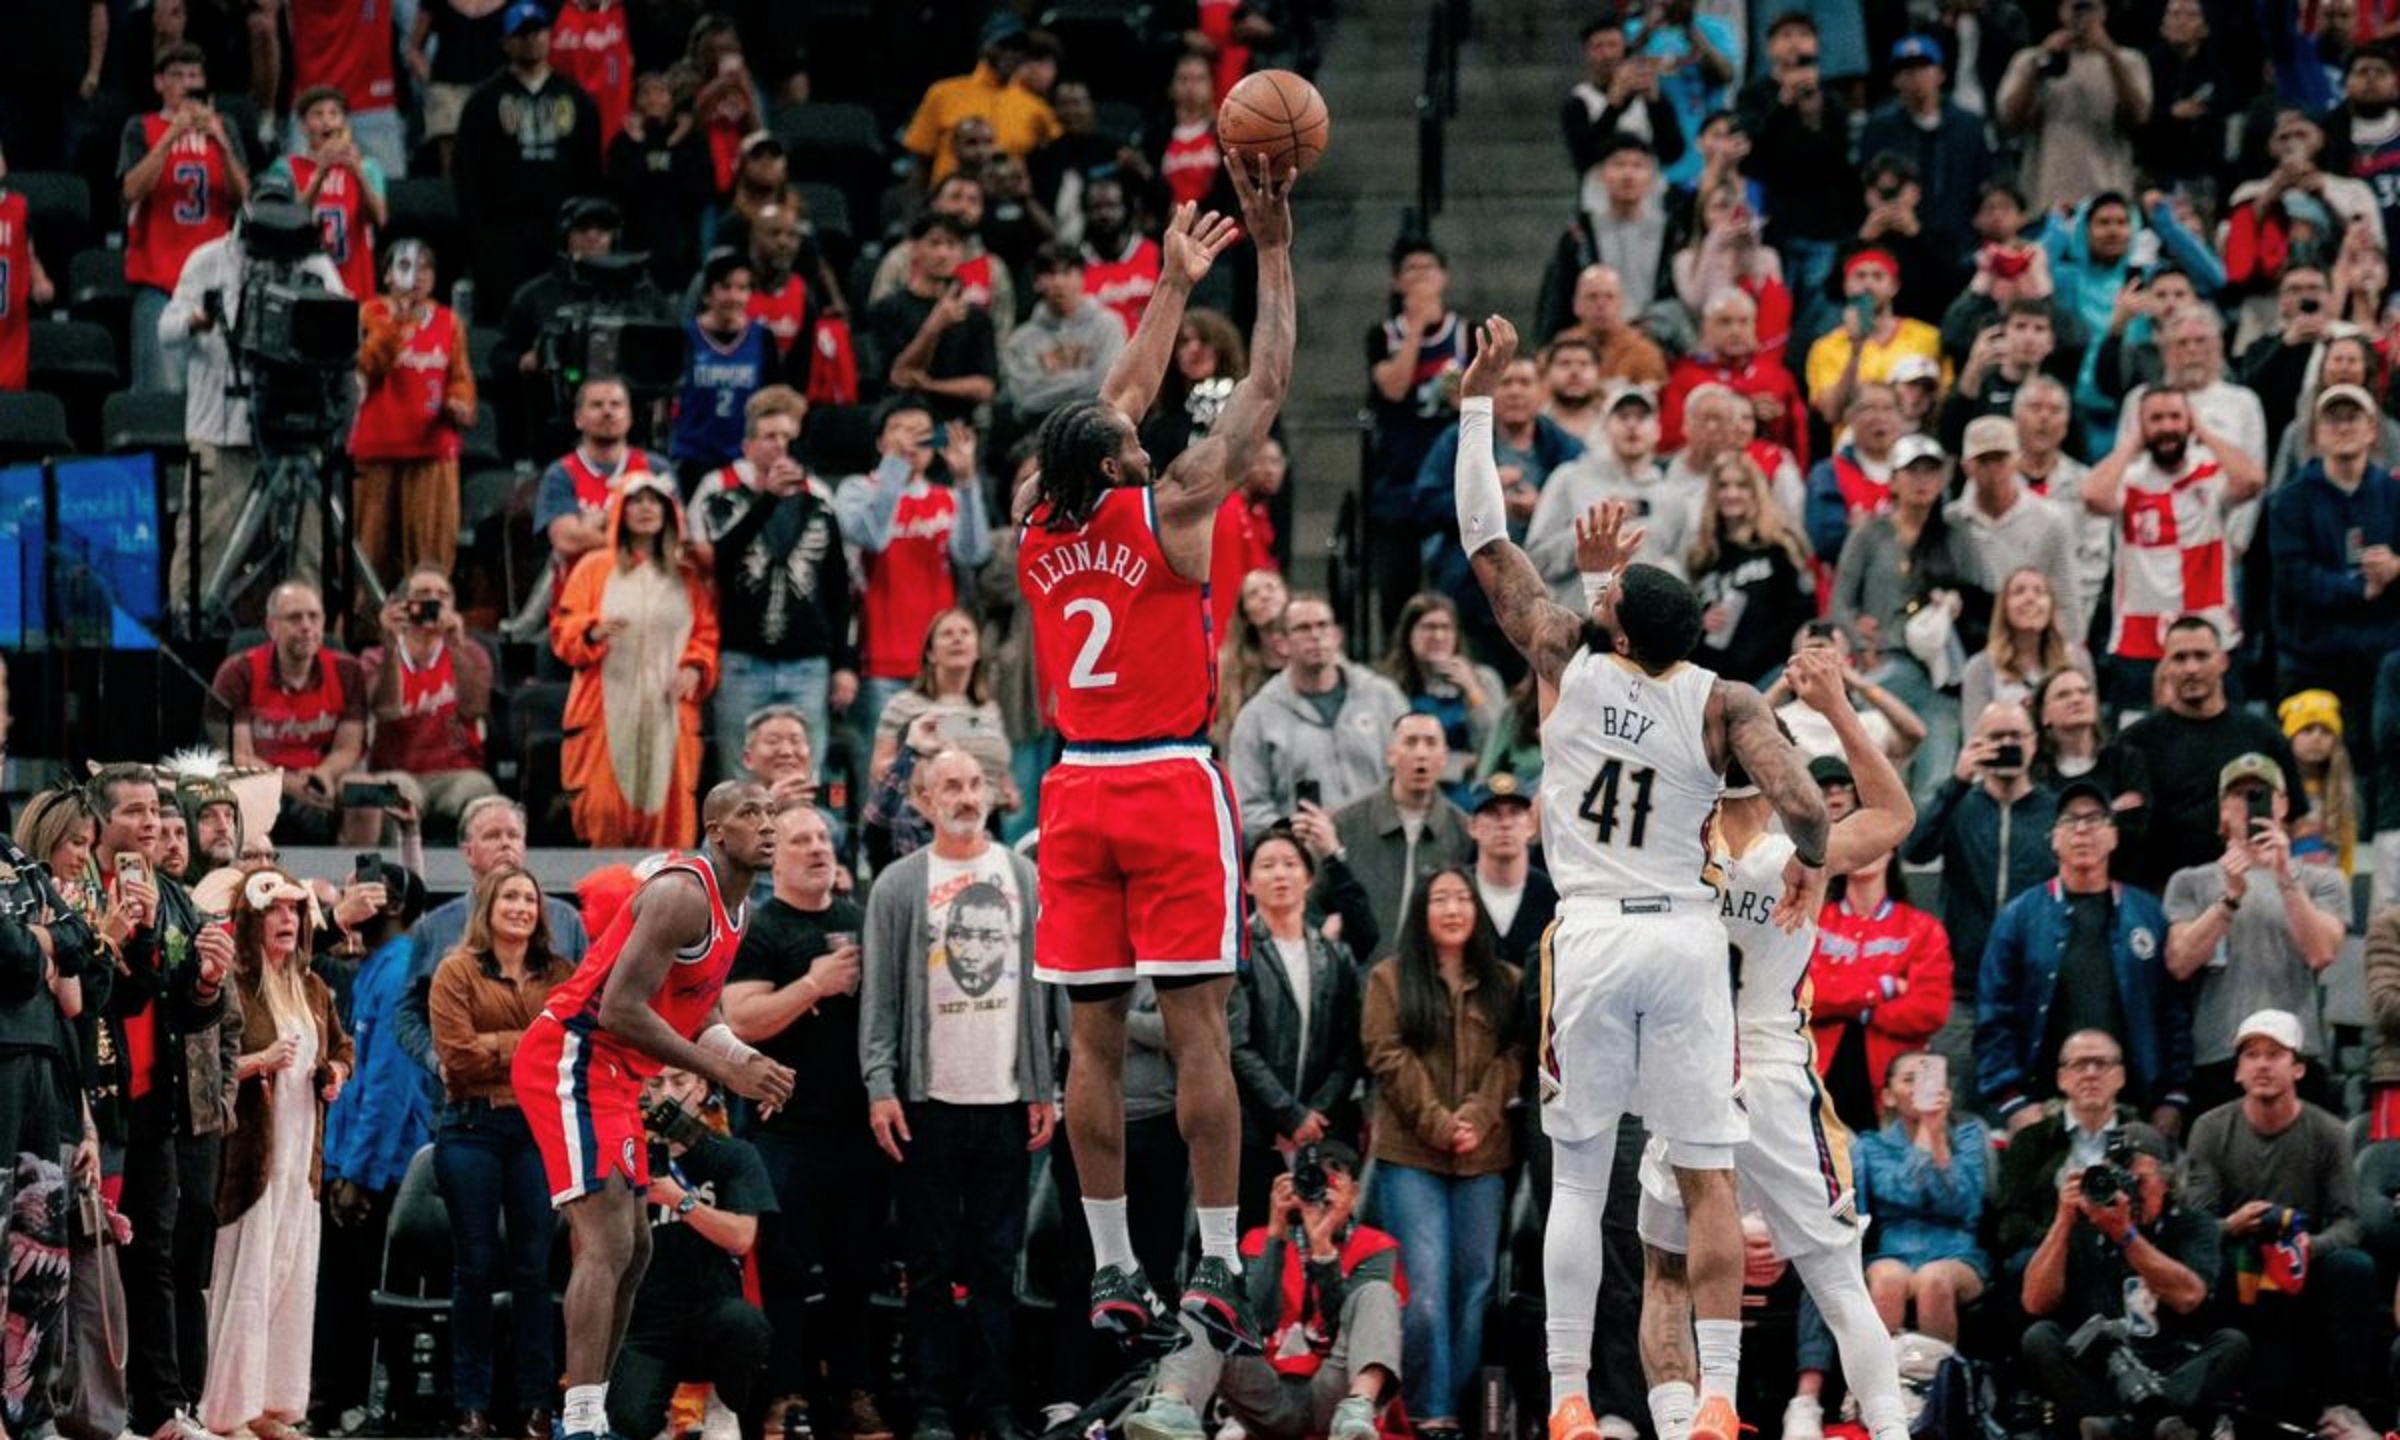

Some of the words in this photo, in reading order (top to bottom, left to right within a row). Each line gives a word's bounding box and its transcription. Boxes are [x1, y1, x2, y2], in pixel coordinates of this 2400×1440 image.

[173, 159, 208, 225] 3
[715, 389, 735, 417] 2
[1027, 539, 1149, 596] LEONARD
[1063, 597, 1118, 690] 2
[1603, 705, 1655, 745] BEY
[1578, 757, 1656, 848] 41
[1720, 889, 1776, 924] ARS
